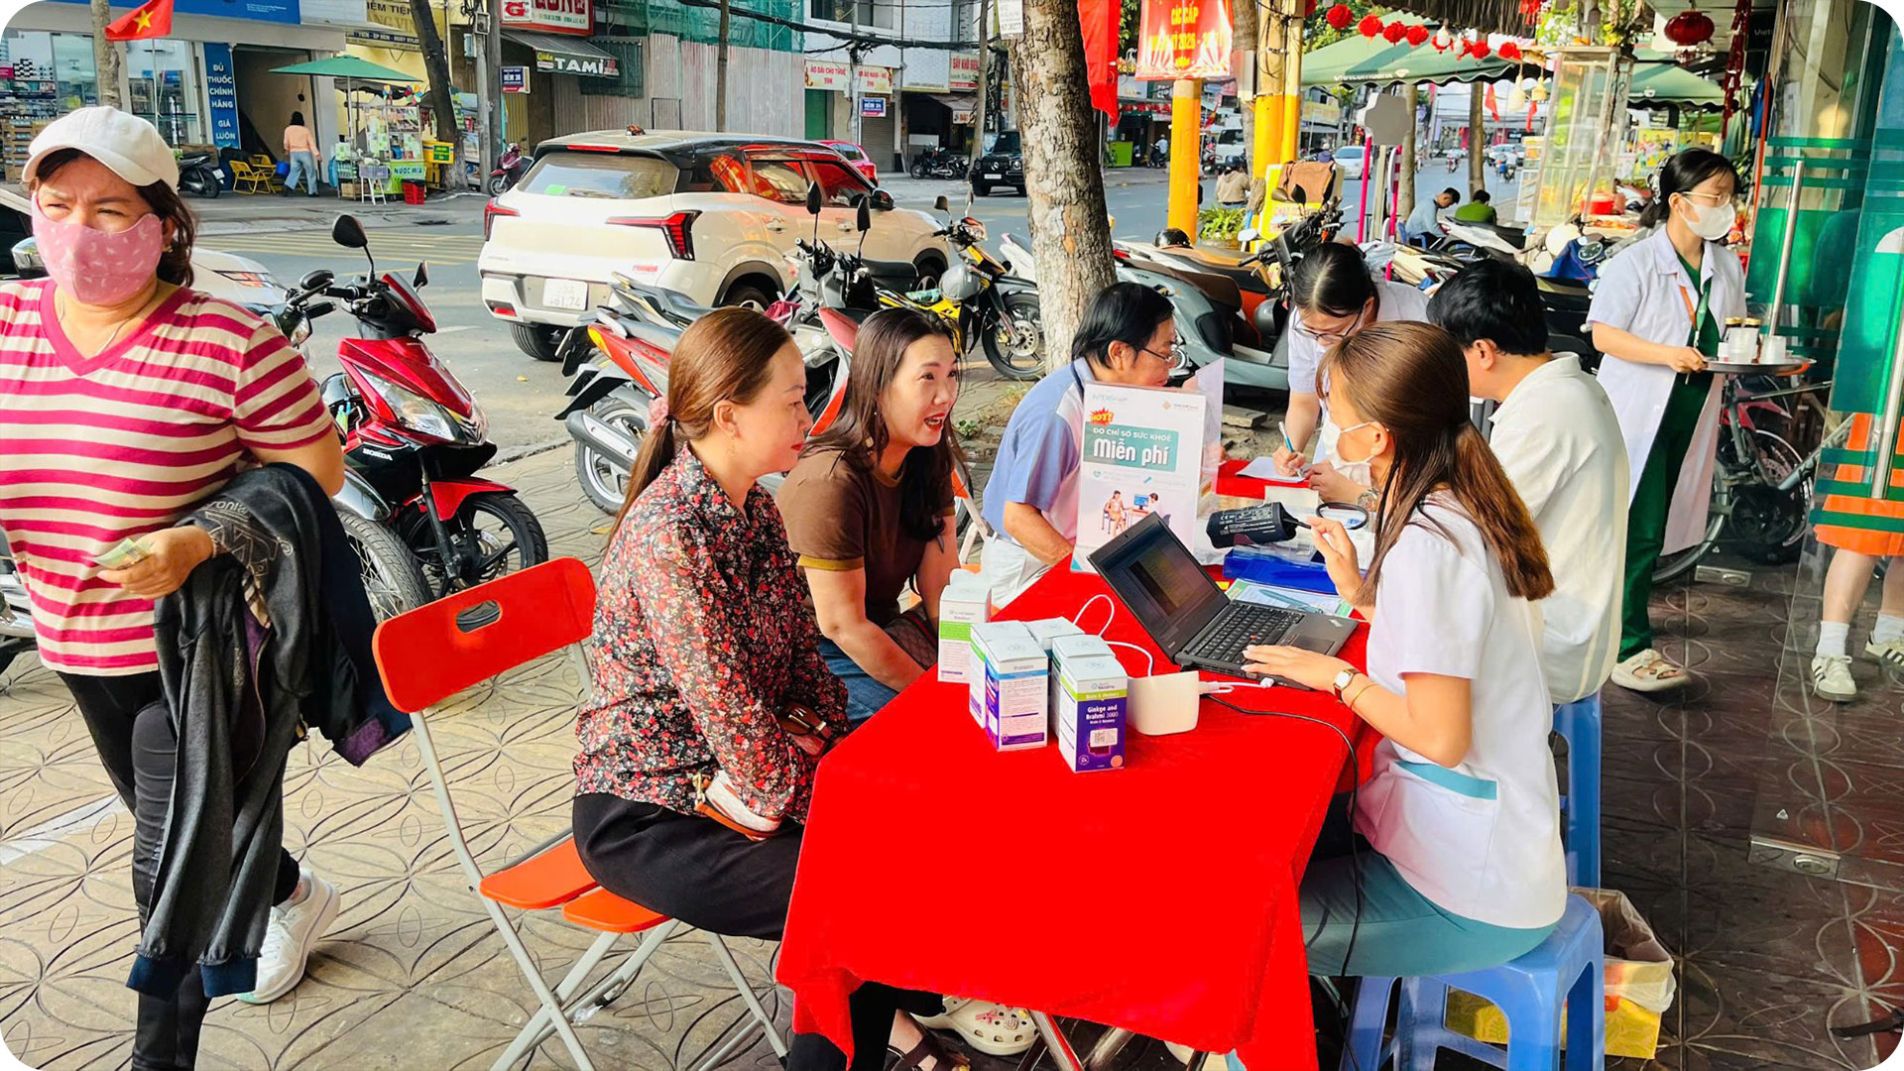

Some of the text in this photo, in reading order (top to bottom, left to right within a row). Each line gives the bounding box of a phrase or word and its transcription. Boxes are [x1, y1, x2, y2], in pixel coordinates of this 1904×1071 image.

[207, 75, 232, 84] THUỐC
[209, 86, 234, 96] CHÍNH
[218, 118, 231, 128] GIÁ
[1133, 431, 1148, 440] SỨC
[362, 447, 393, 461] HONDA
[1093, 438, 1169, 466] Miễn phí
[1087, 705, 1106, 713] Ginkgo
